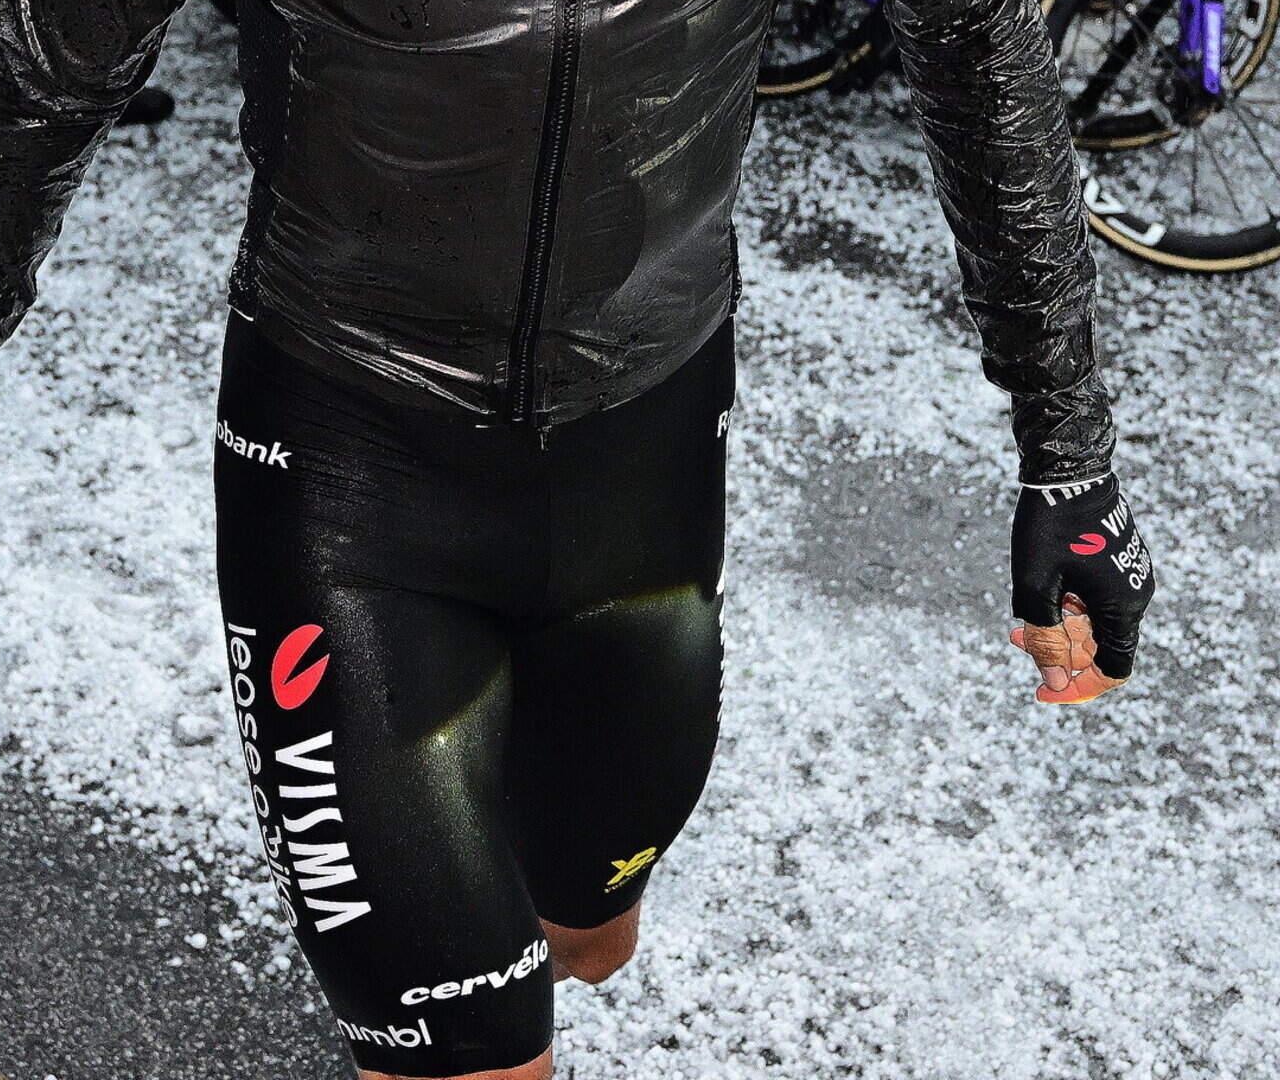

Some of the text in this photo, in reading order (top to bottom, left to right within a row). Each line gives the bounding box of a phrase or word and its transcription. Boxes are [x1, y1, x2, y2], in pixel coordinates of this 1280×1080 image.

[217, 419, 293, 470] obank
[227, 621, 263, 776] lease
[275, 729, 372, 934] VISMA
[400, 938, 549, 1006] cervélo
[336, 1018, 433, 1049] nimbl
